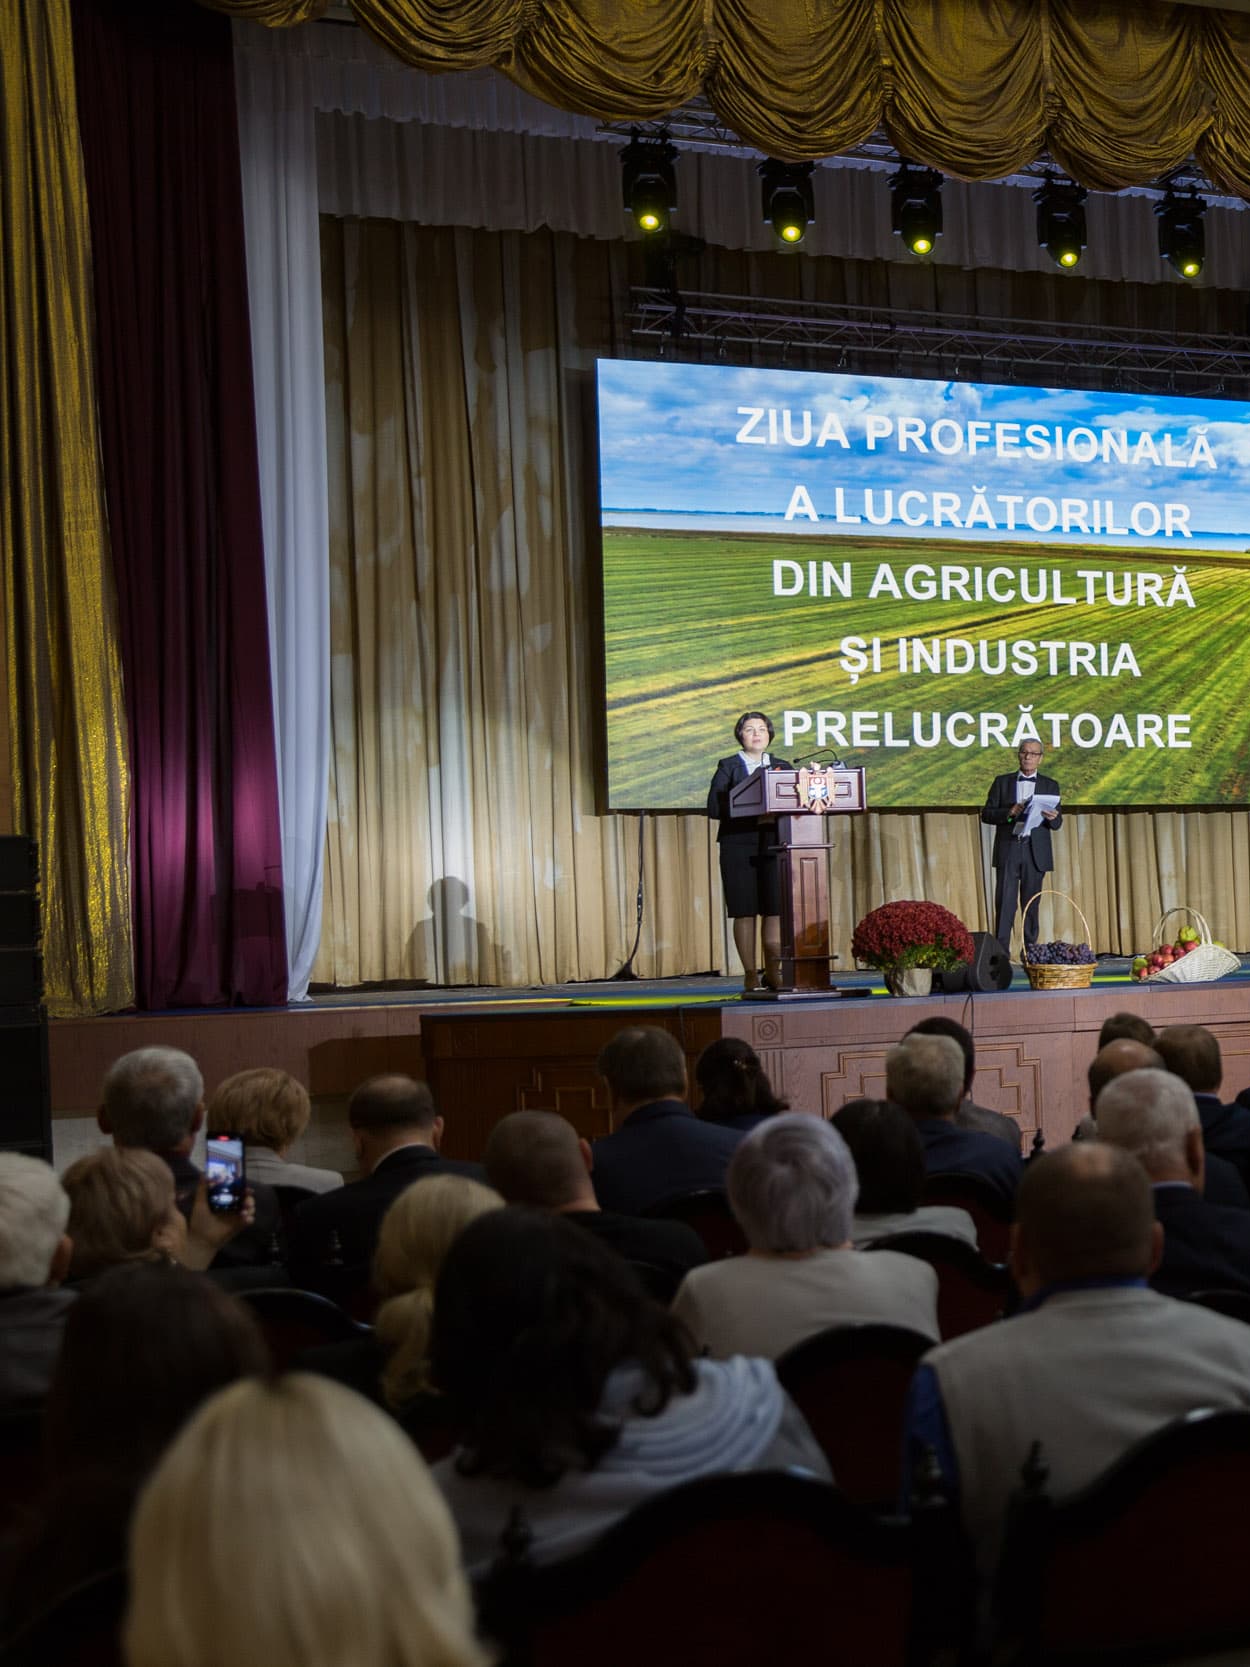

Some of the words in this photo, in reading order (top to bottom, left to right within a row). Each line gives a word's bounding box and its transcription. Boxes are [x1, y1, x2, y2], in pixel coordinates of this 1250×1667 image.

[736, 407, 850, 450] ZIUA
[866, 413, 1218, 470] PROFESIONALĂ
[784, 485, 820, 522] A
[835, 485, 1193, 538] LUCRĂTORILOR
[772, 559, 853, 598] DIN
[868, 563, 1196, 608] AGRICULTURĂ
[839, 635, 881, 685] ȘI
[899, 638, 1142, 677] INDUSTRIA
[783, 704, 1193, 749] PRELUCRĂTOARE
